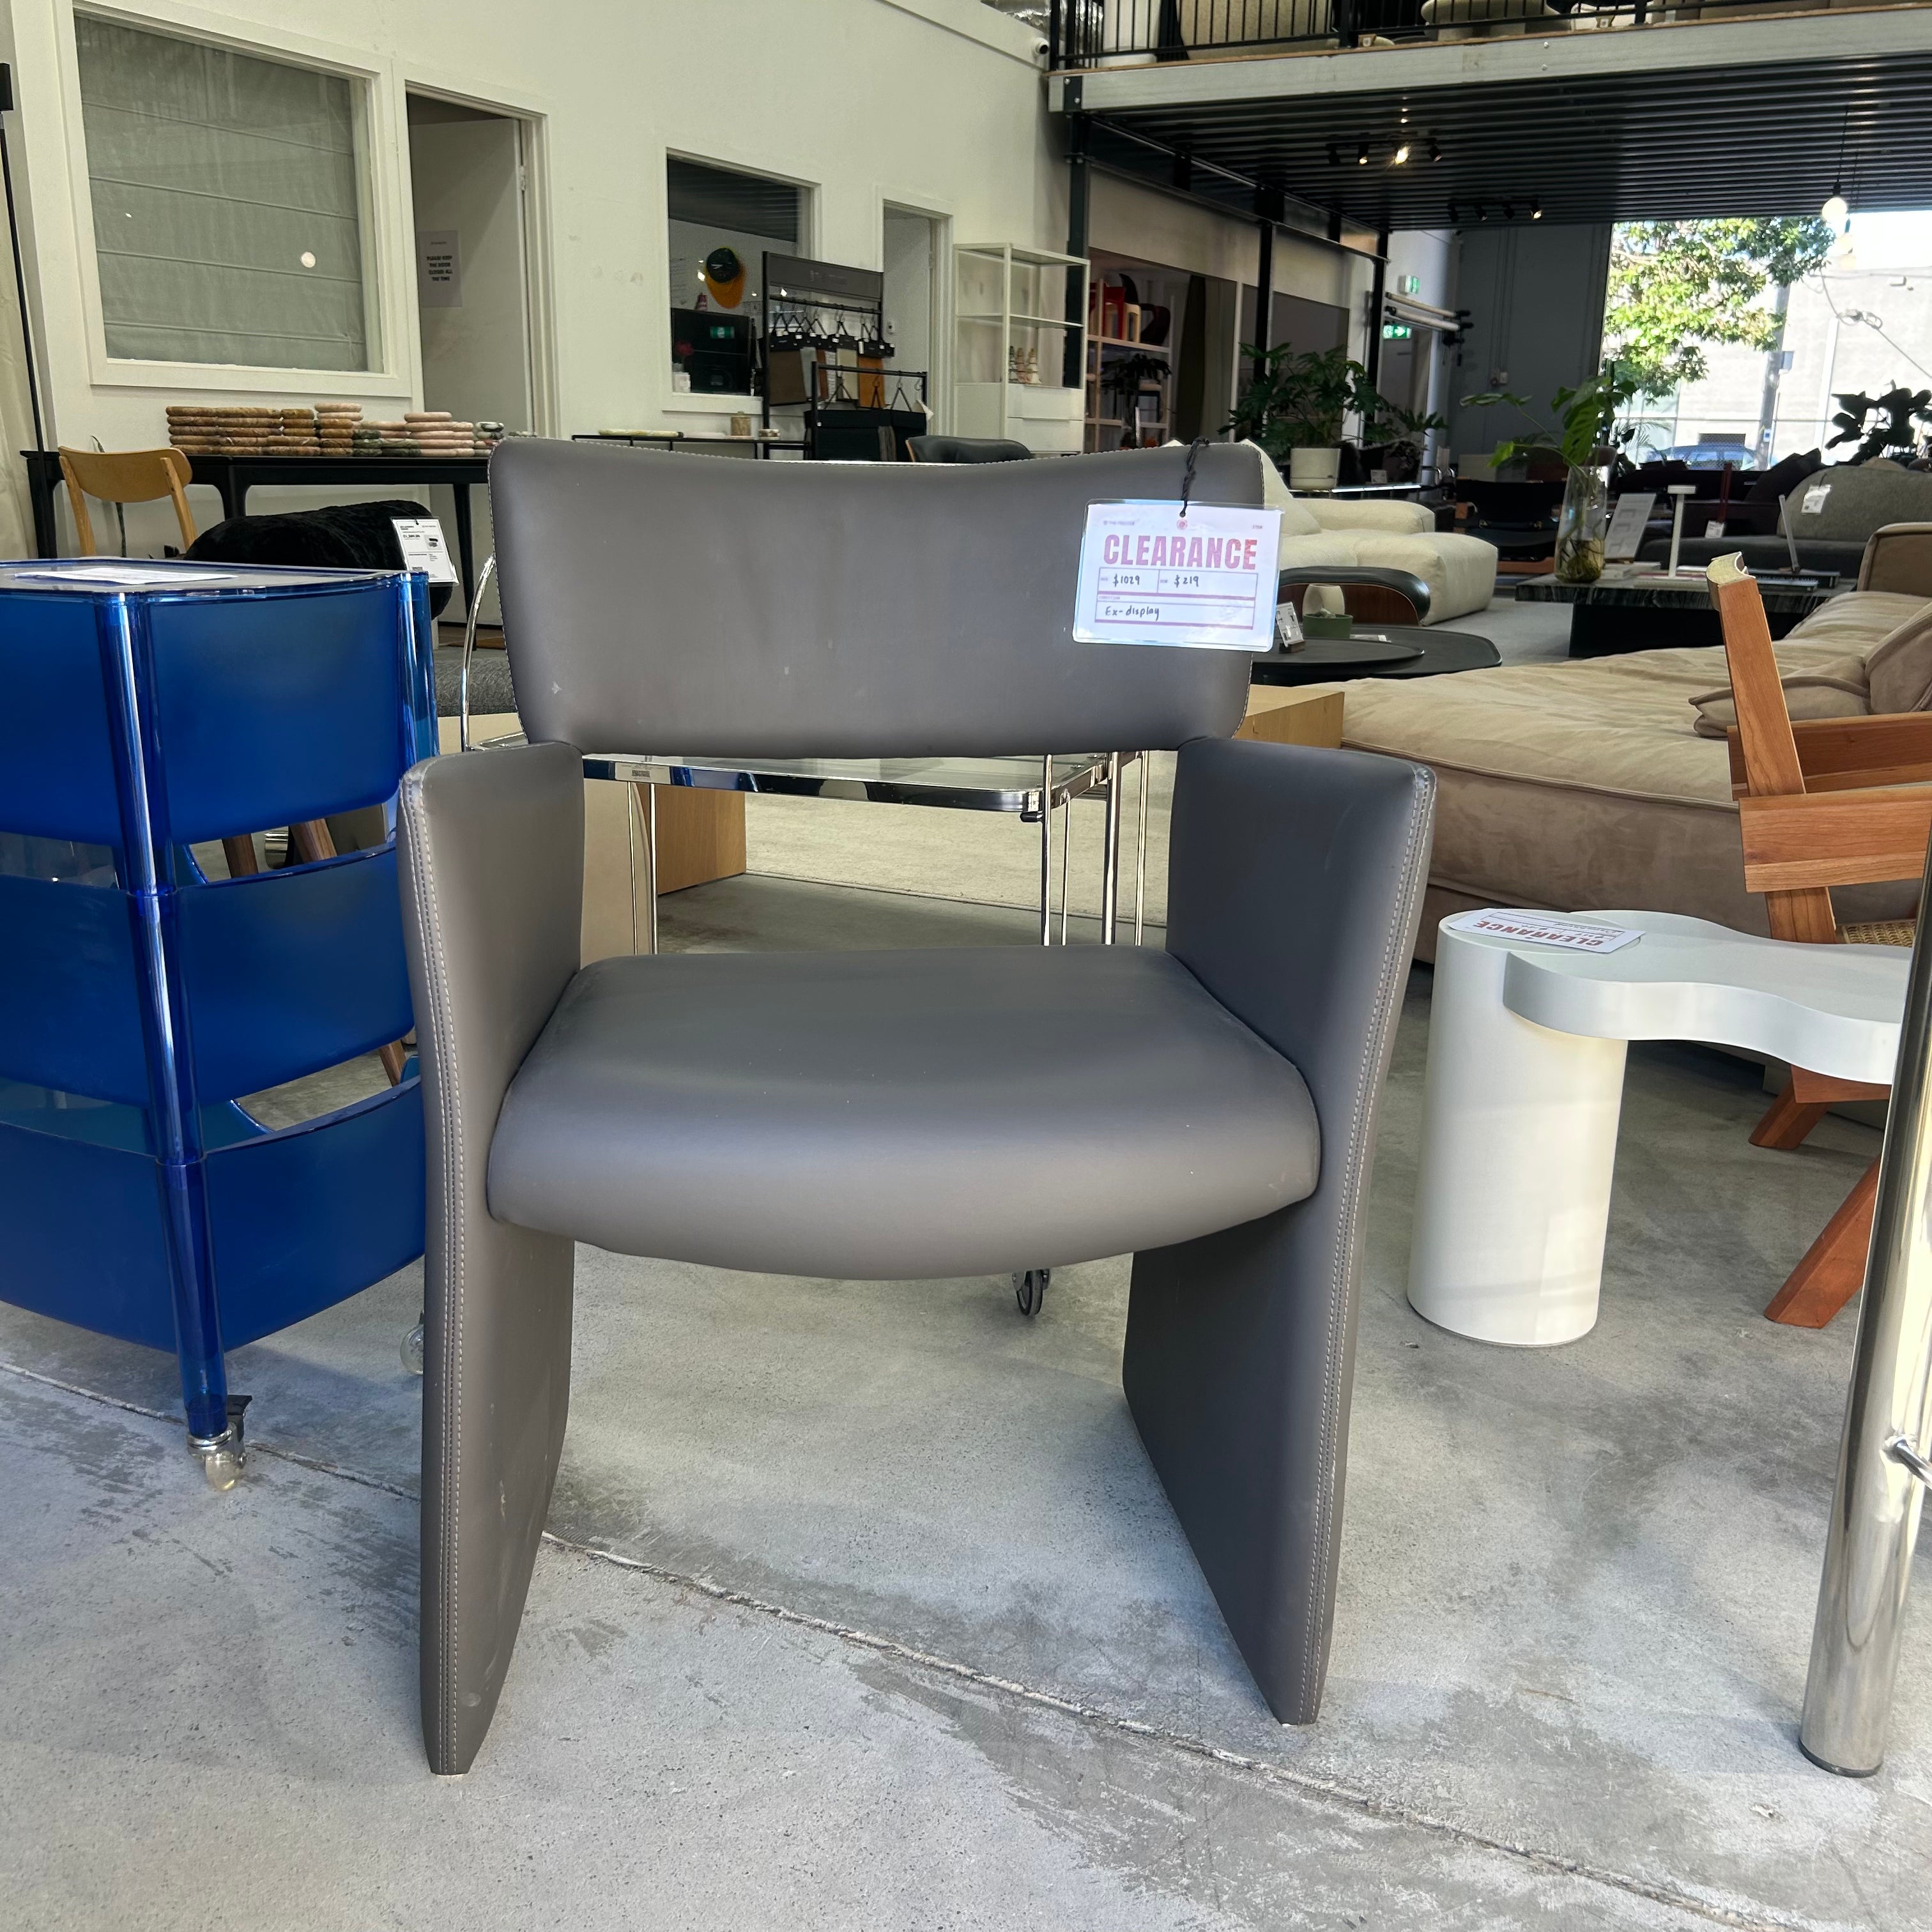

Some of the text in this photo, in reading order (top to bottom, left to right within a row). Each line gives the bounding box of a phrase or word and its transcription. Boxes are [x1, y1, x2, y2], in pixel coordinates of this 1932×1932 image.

[1103, 534, 1257, 569] CLEARANCE
[1112, 574, 1140, 587] $1029
[1105, 605, 1160, 621] Ex-display
[1473, 920, 1603, 946] CLEARANCE
